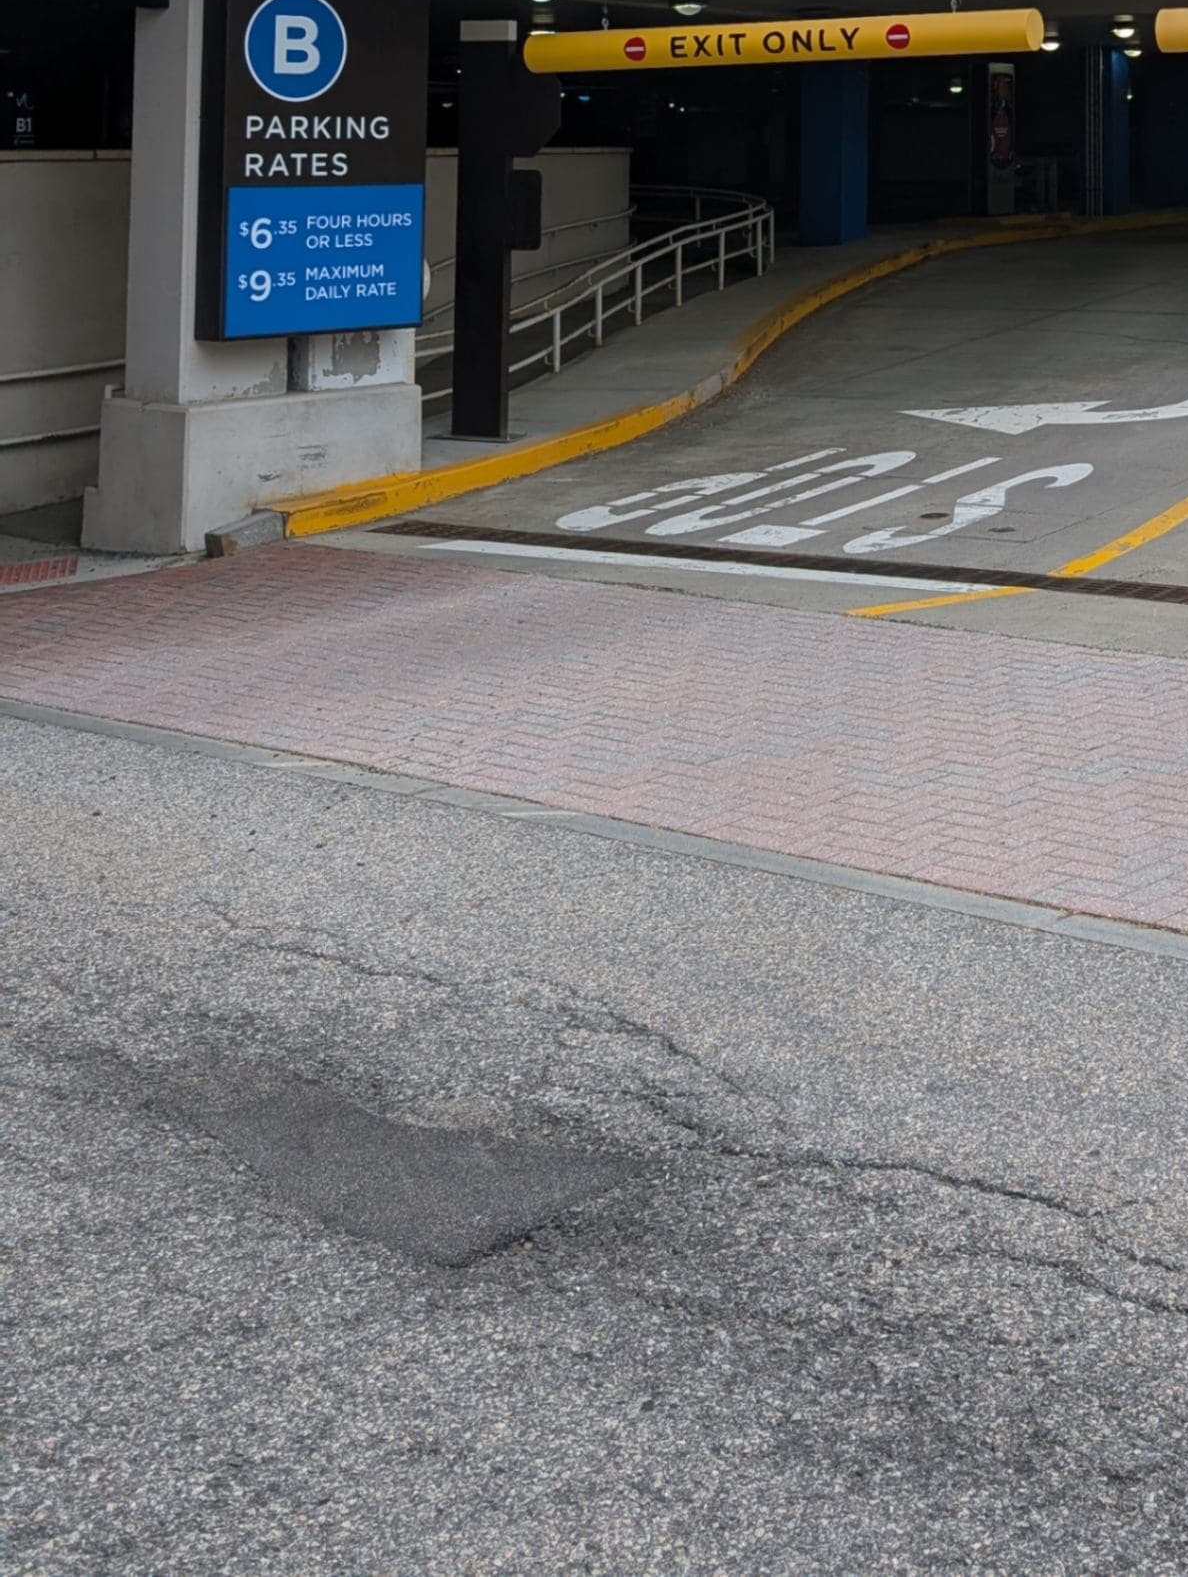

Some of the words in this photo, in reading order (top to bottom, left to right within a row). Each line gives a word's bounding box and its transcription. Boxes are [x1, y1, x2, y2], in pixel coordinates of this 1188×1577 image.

[273, 14, 321, 76] B
[669, 33, 747, 59] EXIT
[762, 27, 860, 54] ONLY
[15, 117, 32, 133] B1
[245, 114, 390, 141] PARKING
[243, 153, 350, 178] RATES
[306, 215, 352, 230] FOUR
[356, 213, 412, 228] HOURS
[305, 234, 330, 250] OR
[334, 233, 373, 248] LESS
[305, 264, 385, 281] MAXIMUM
[304, 284, 349, 302] DAILY
[356, 282, 397, 298] RATE
[555, 447, 1094, 554] STOP
